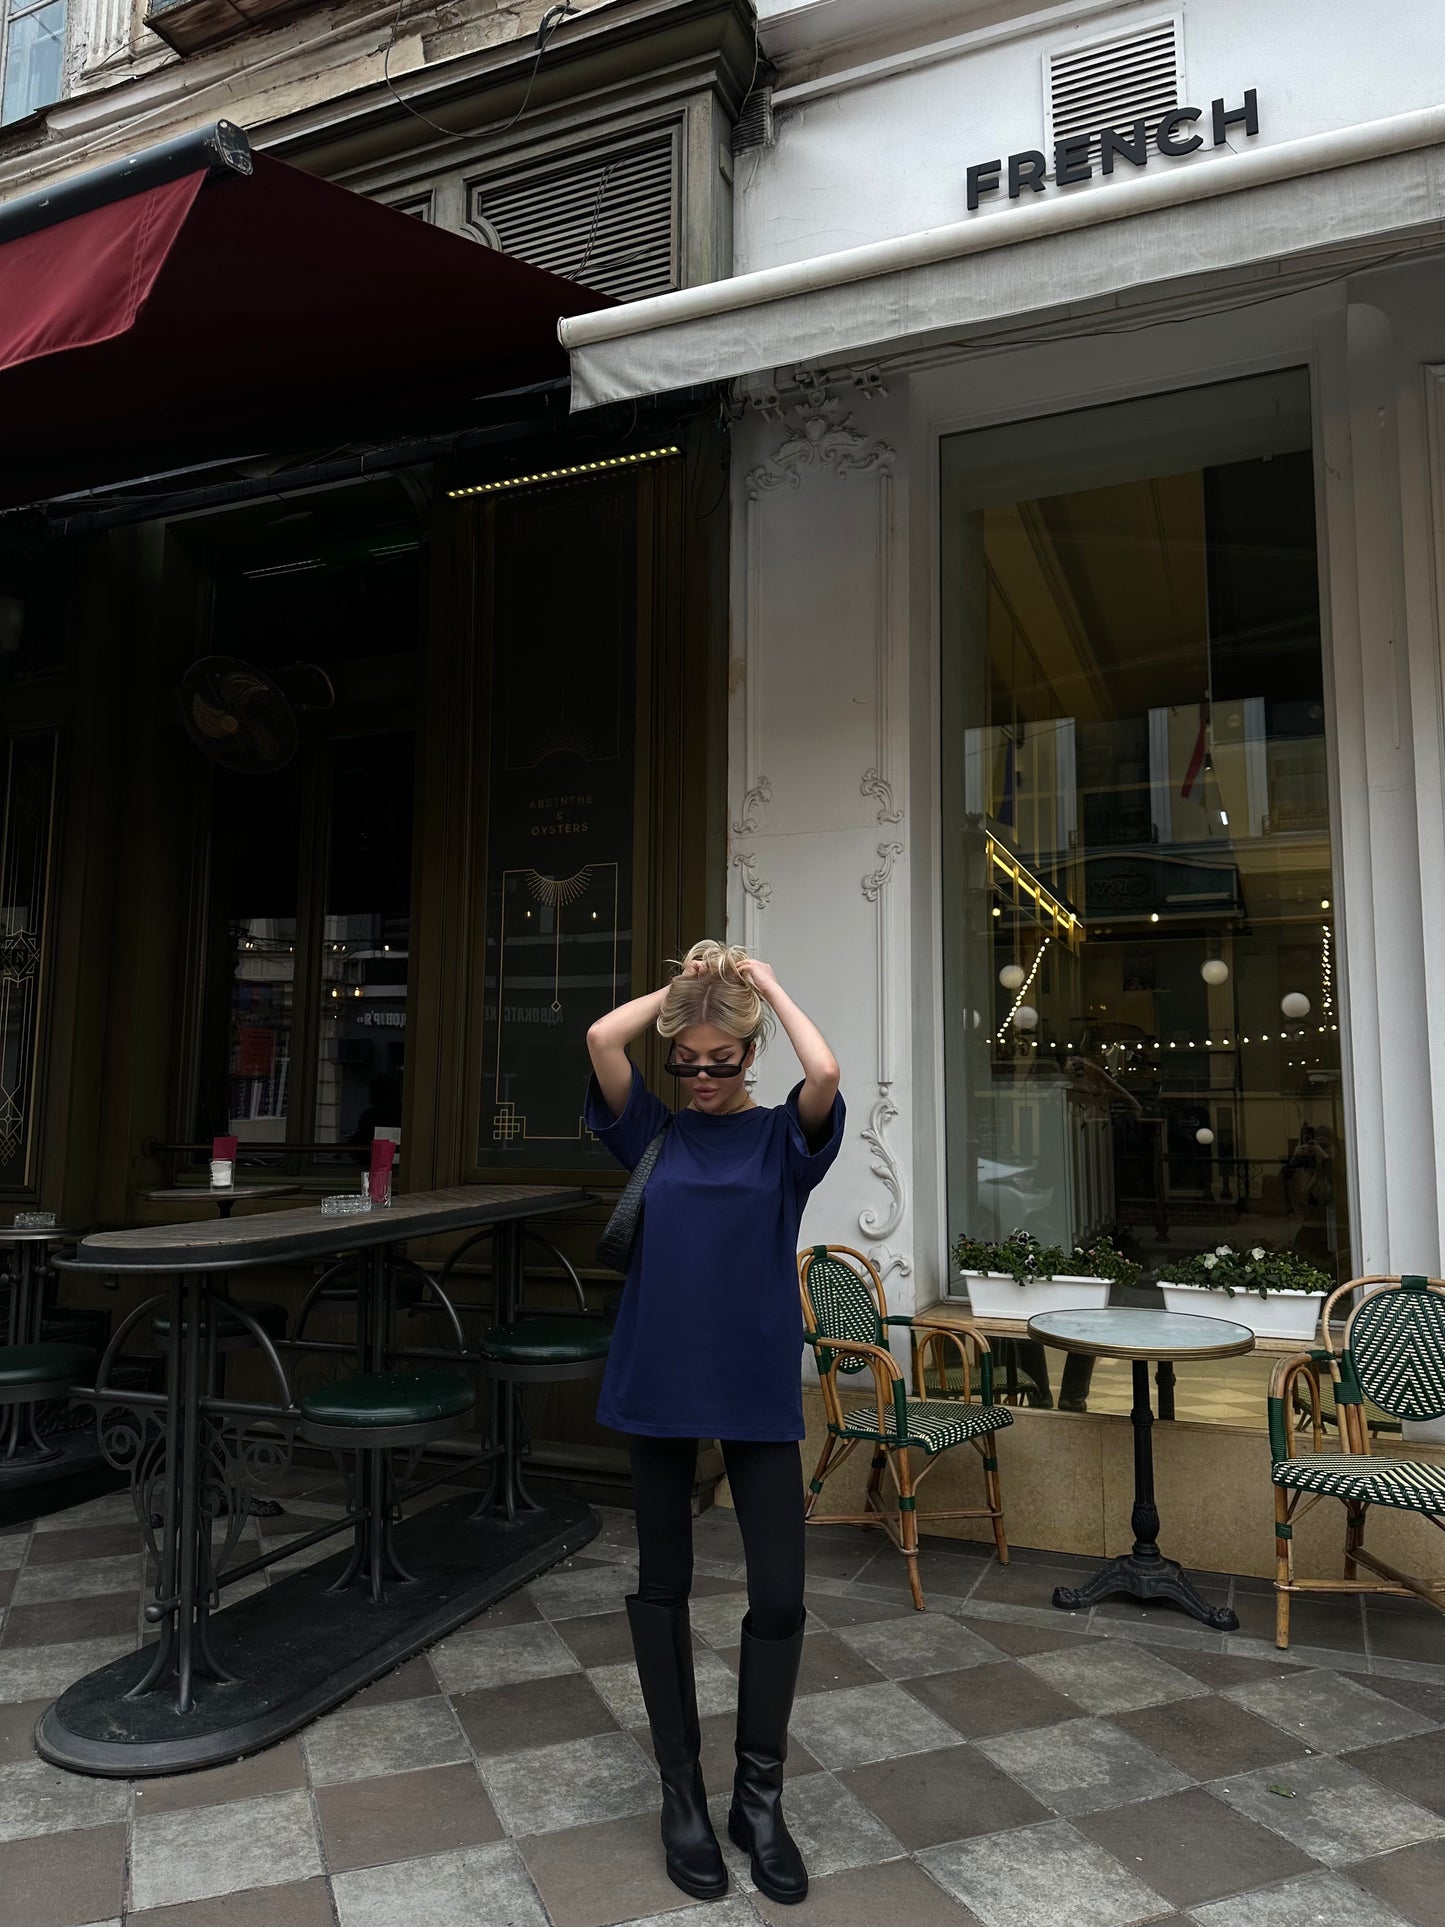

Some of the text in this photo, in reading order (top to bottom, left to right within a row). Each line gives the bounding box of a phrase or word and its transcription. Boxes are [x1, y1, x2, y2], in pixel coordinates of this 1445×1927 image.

[966, 88, 1259, 211] FRENCH
[528, 794, 593, 810] ABSINTHE
[556, 811, 563, 820] &
[531, 822, 589, 836] OYSTERS
